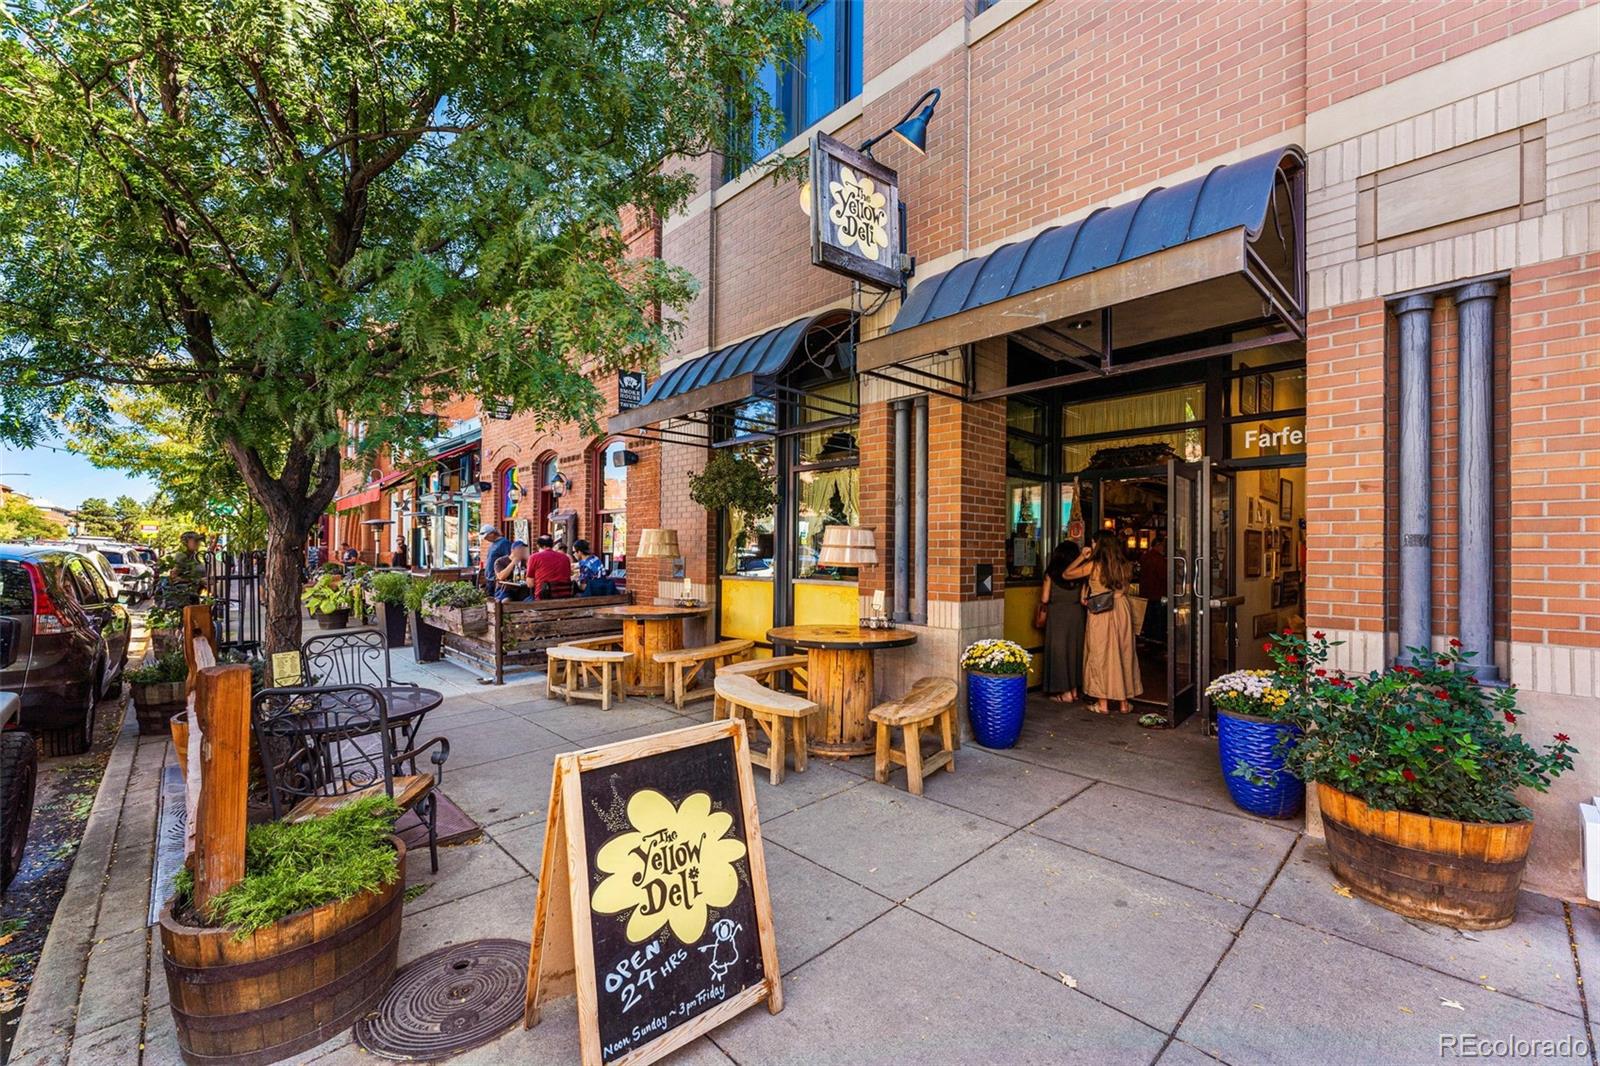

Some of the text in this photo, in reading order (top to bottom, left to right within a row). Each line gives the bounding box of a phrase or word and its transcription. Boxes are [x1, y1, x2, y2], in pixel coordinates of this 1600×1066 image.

[835, 189, 885, 225] Yellow
[845, 181, 871, 203] The
[842, 215, 875, 247] Deli
[620, 388, 641, 396] SMOKE
[642, 828, 678, 844] The
[628, 832, 706, 887] Yellow
[640, 866, 703, 916] Deli
[605, 940, 660, 993] OPEN
[621, 948, 688, 1014] 24 HRS
[603, 1036, 630, 1059] Noon
[632, 1015, 668, 1041] Sunday
[695, 983, 726, 1006] Friday
